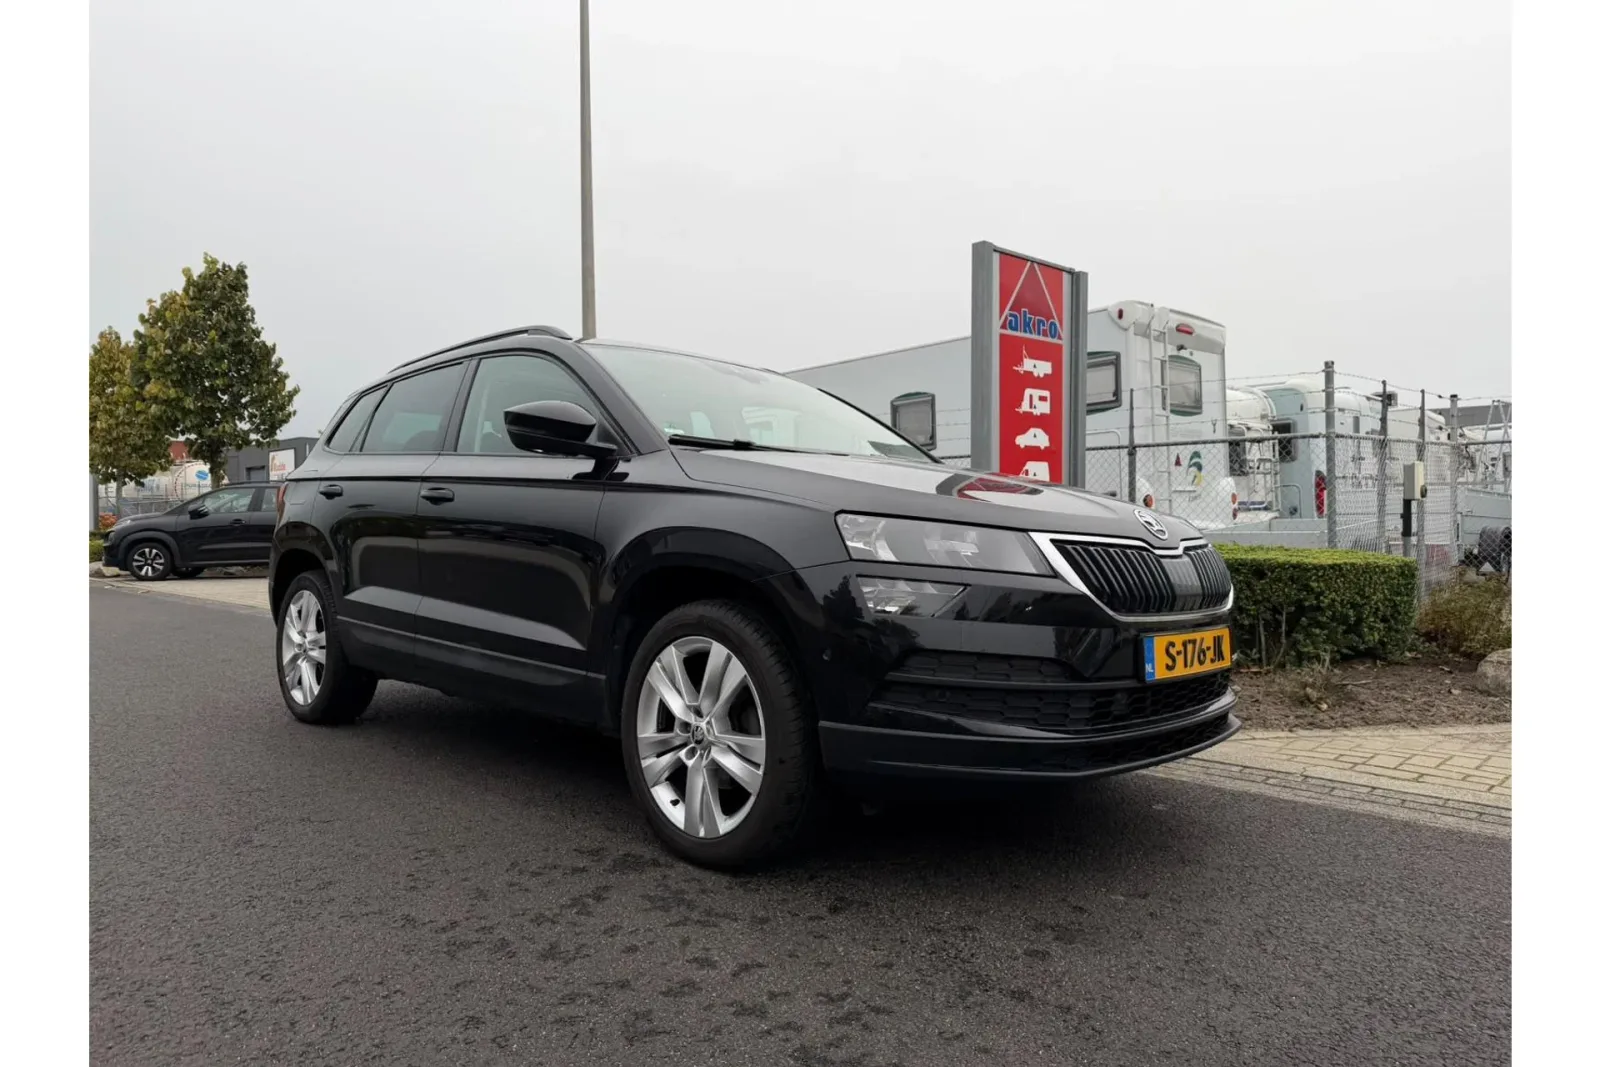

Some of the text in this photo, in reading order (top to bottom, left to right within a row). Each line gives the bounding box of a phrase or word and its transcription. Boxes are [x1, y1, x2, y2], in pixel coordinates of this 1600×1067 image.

[1007, 308, 1058, 340] akro
[1145, 663, 1154, 673] NL
[1165, 634, 1225, 671] S-176-JK
